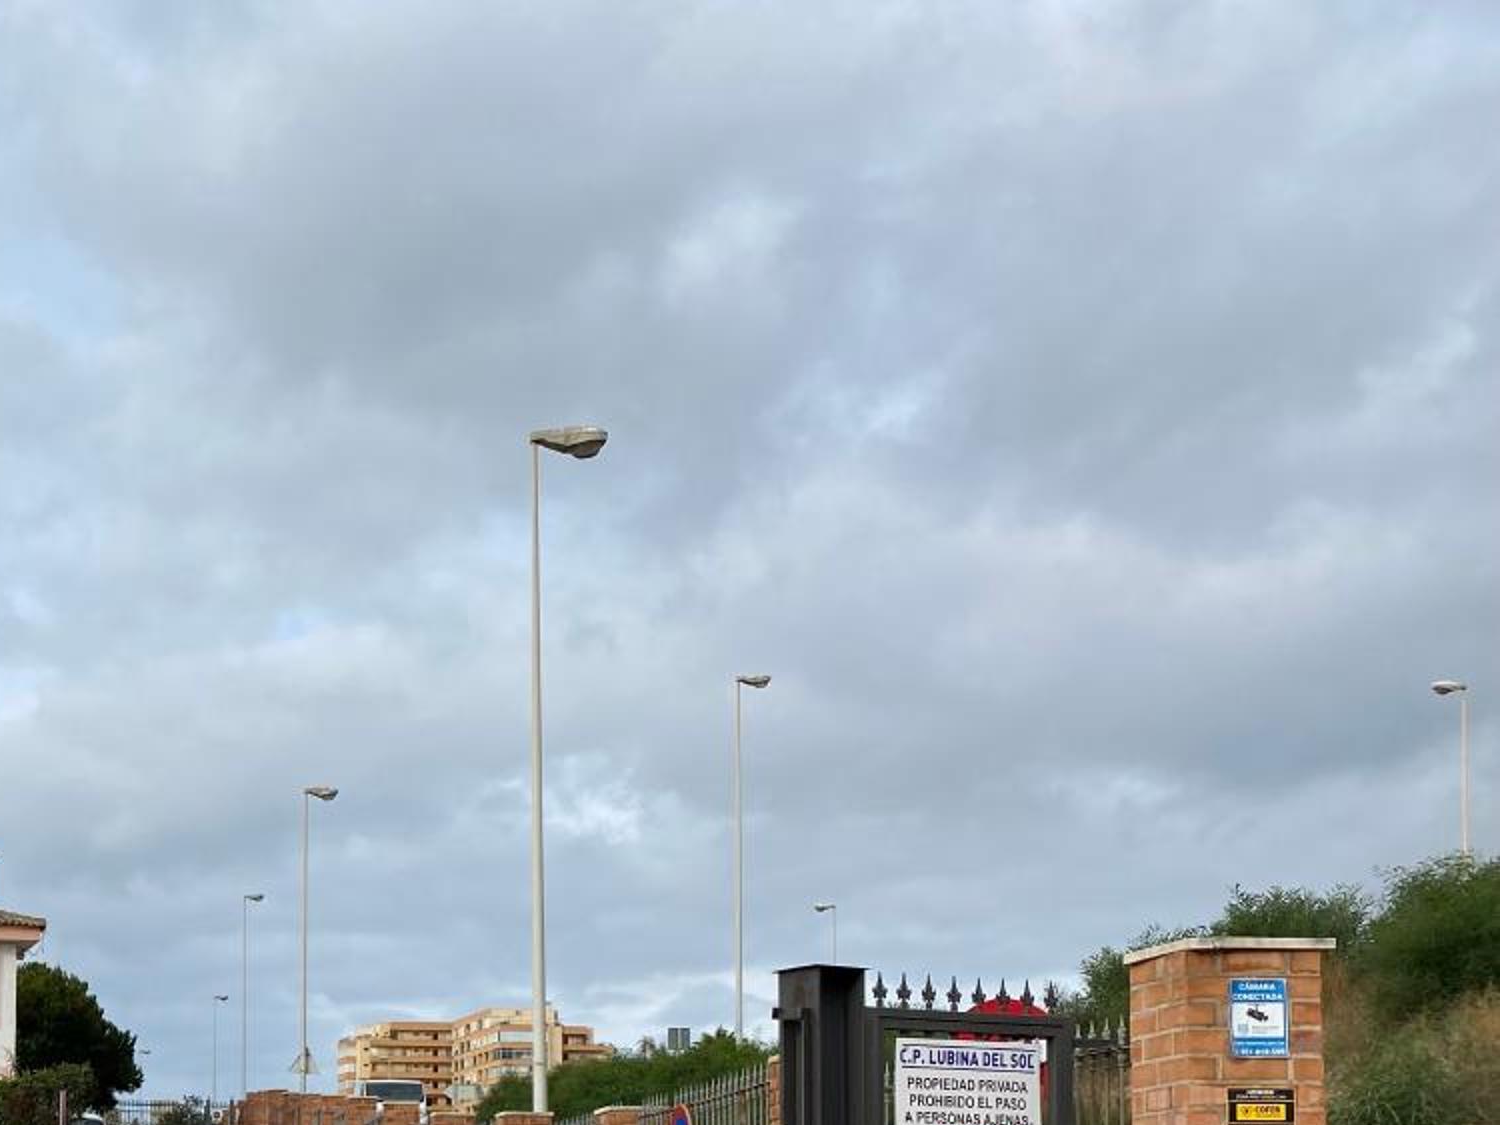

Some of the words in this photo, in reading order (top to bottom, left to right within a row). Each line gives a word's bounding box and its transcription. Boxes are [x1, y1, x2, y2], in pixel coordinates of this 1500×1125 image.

[900, 1048, 925, 1065] C.P.
[929, 1050, 979, 1067] LUBINA
[983, 1052, 1007, 1068] DEL
[907, 1077, 975, 1091] PROPIEDAD
[979, 1080, 1028, 1093] PRIVADA
[909, 1094, 975, 1109] PROHIBIDO
[977, 1097, 992, 1109] EL
[996, 1097, 1027, 1111] PASO
[905, 1111, 913, 1122] A
[916, 1112, 980, 1125] PERSONAS
